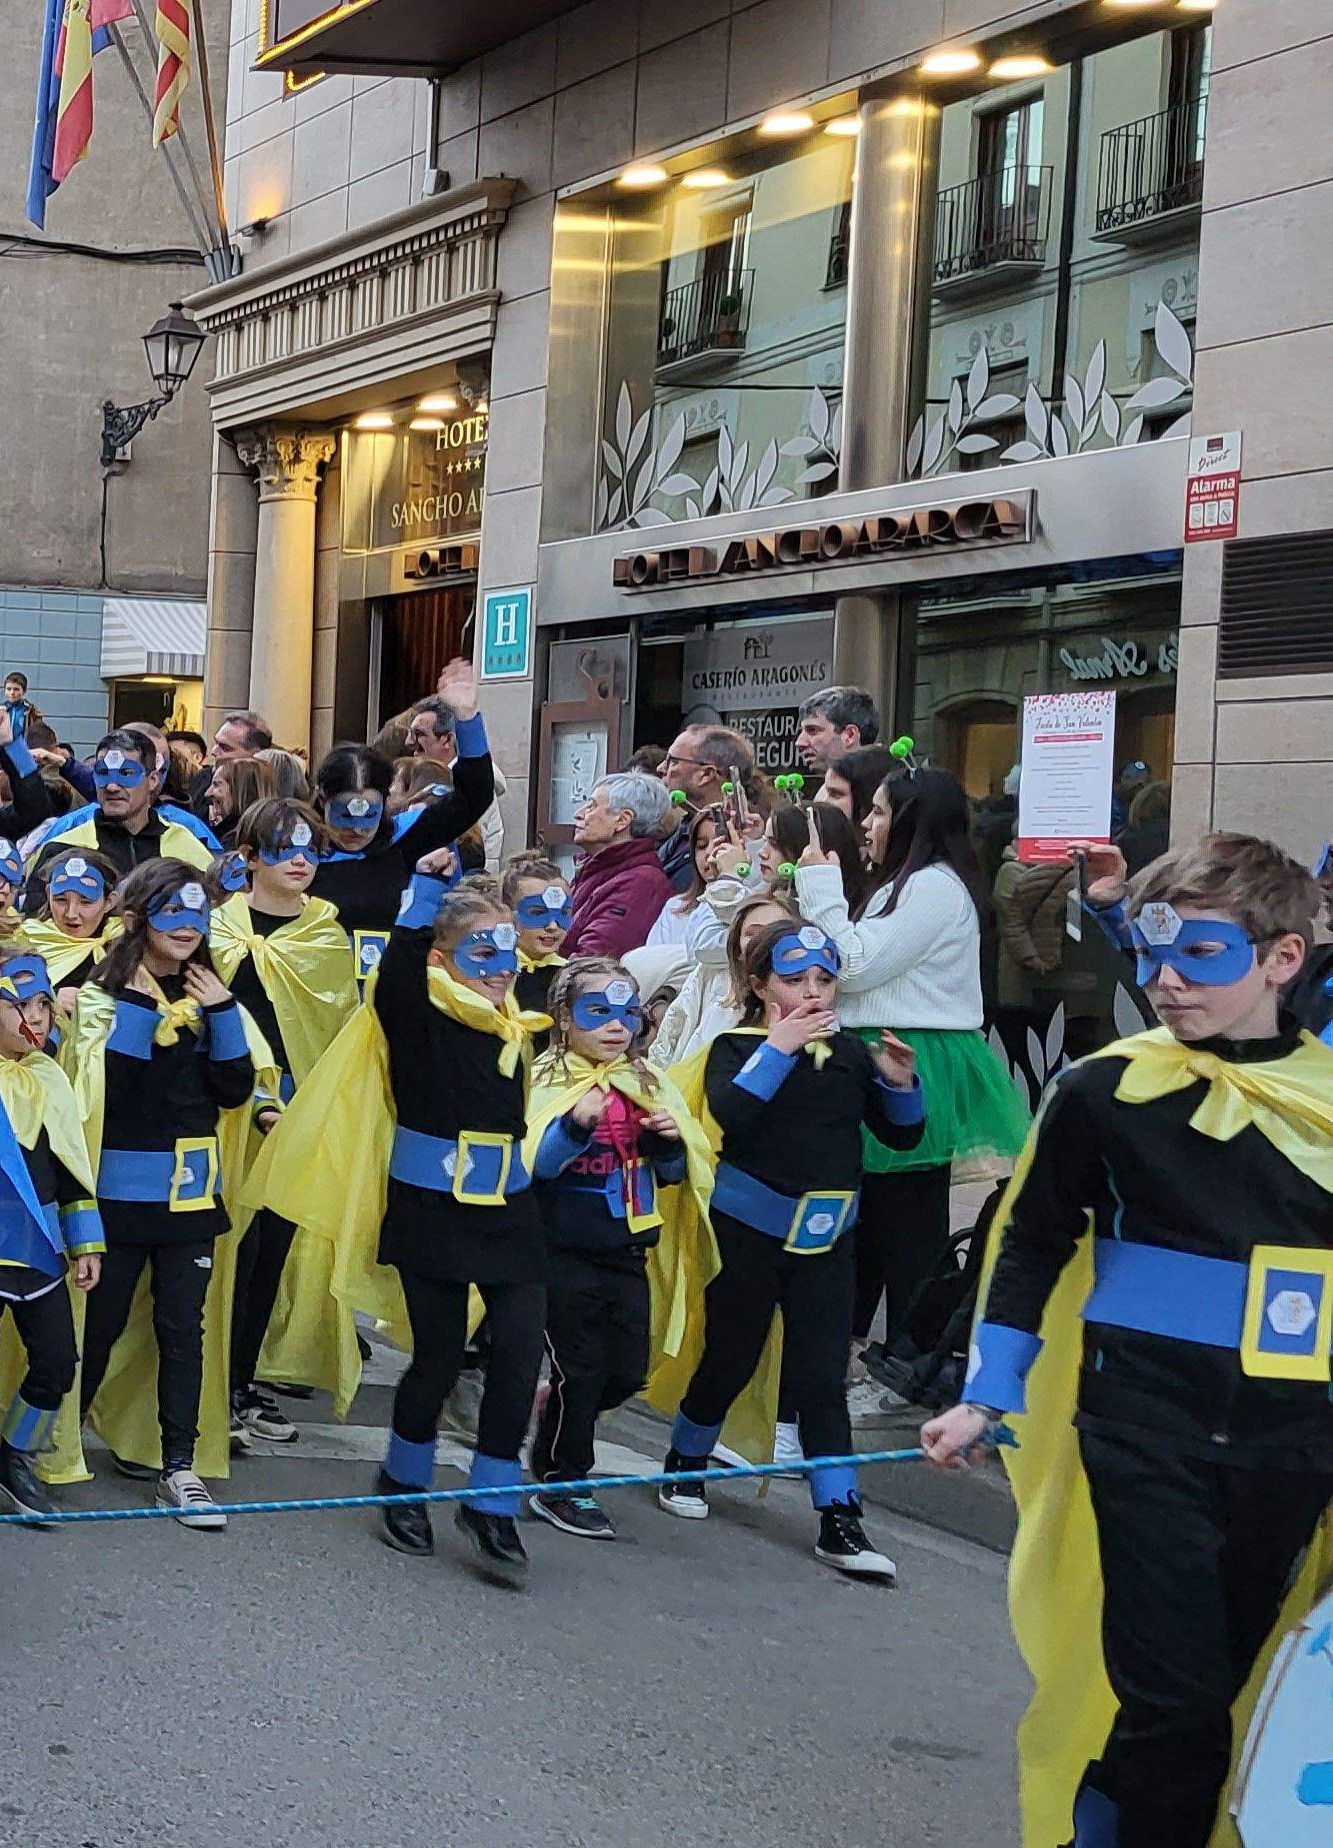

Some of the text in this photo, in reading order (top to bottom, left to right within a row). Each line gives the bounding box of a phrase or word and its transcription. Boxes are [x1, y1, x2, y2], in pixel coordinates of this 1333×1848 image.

[436, 414, 490, 451] HOTE
[1190, 477, 1236, 495] Alarma
[390, 492, 463, 529] SANCHO
[493, 602, 520, 647] H
[692, 660, 826, 690] CASERÍO ARAGONÉS
